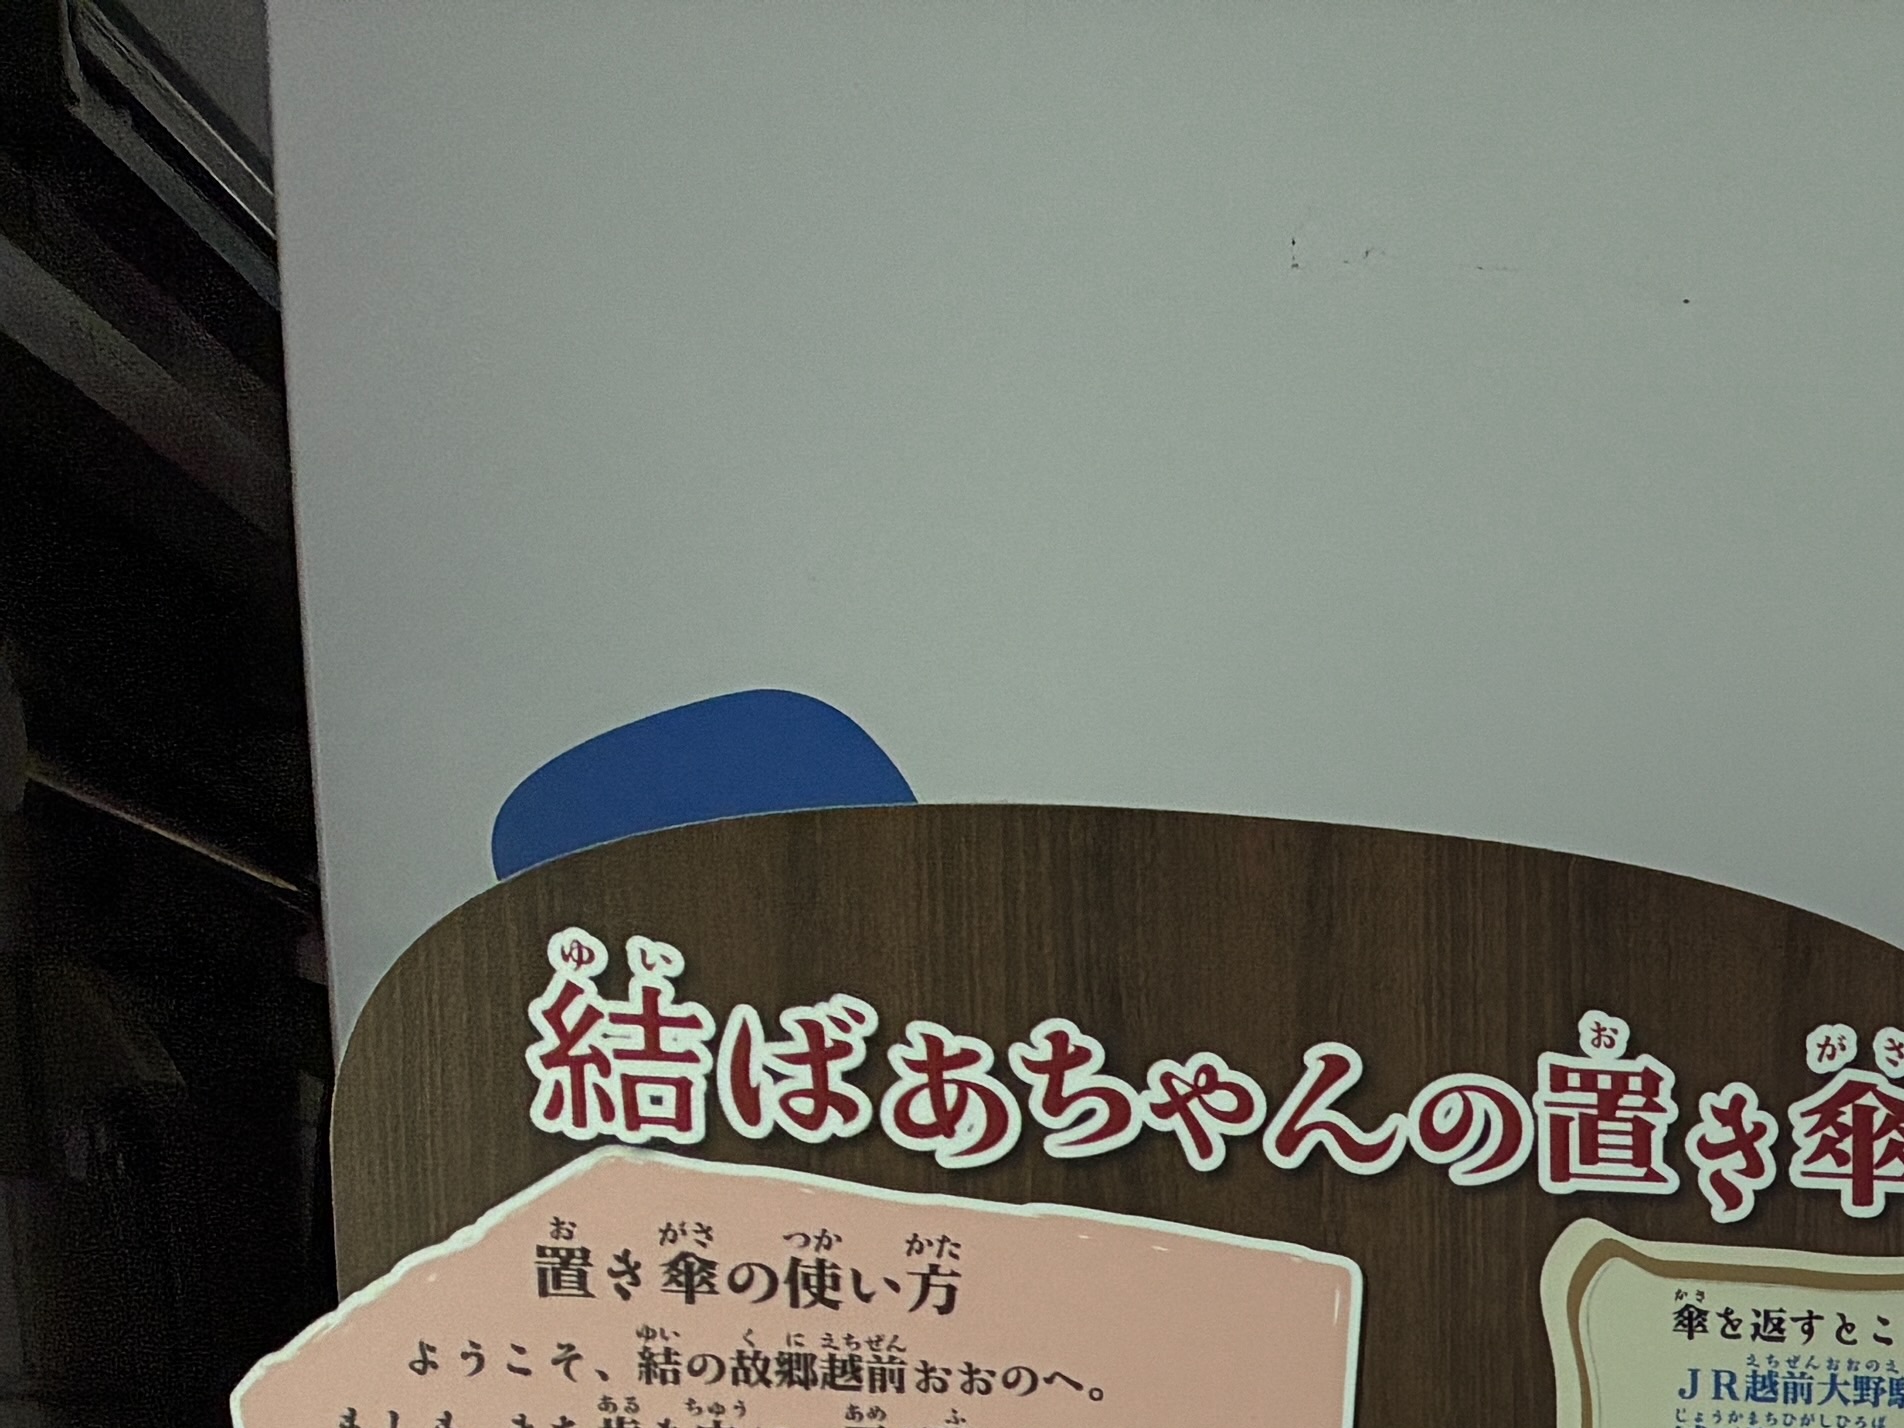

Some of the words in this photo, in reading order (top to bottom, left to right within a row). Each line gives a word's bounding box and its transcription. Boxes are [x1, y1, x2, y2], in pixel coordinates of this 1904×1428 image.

[556, 934, 680, 974] ゆい
[1586, 1016, 1622, 1054] お
[545, 1212, 580, 1243] お
[655, 1217, 718, 1248] がさ
[781, 1225, 844, 1253] つか
[902, 1230, 964, 1262] かた
[532, 1244, 966, 1320] 置き傘の使い方
[634, 1322, 682, 1343] ゆい
[818, 1330, 909, 1353] えちぜん
[406, 1339, 1107, 1403] ようこそ、結の故郷越前おおのへ。
[595, 1394, 642, 1416] ある
[682, 1396, 748, 1419] ちゅう
[842, 1402, 889, 1422] あめ
[944, 1407, 968, 1425] ふ
